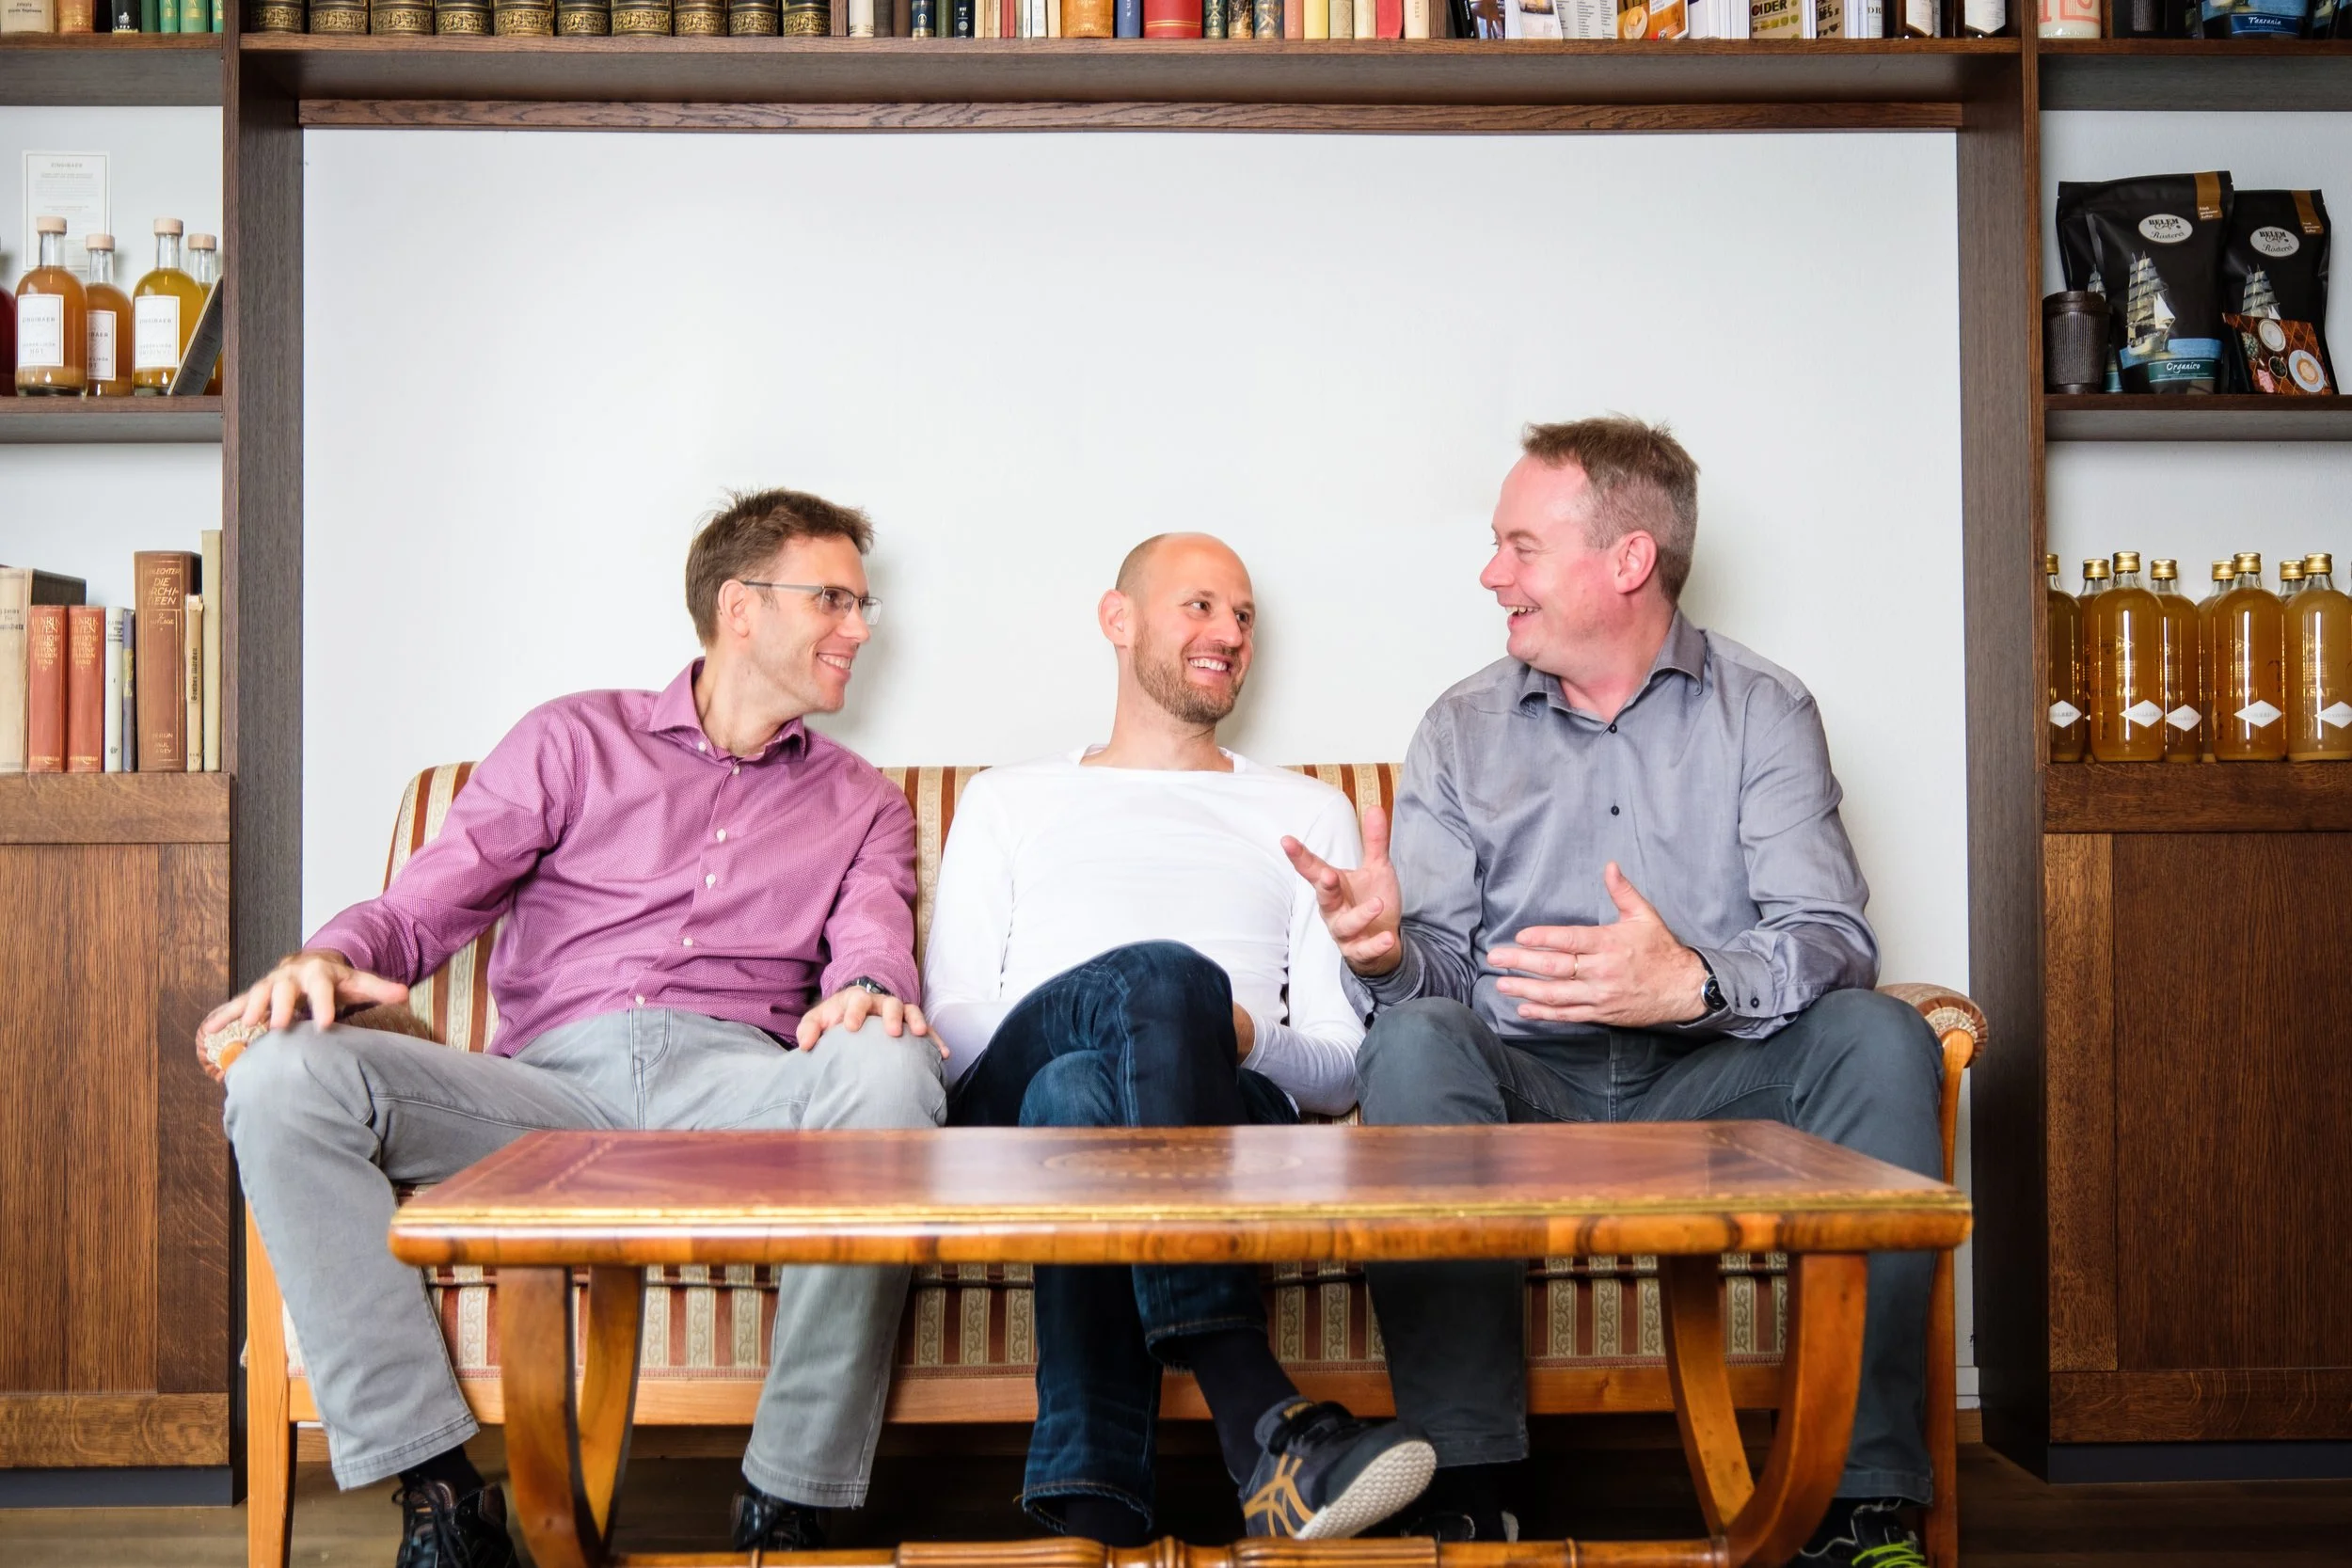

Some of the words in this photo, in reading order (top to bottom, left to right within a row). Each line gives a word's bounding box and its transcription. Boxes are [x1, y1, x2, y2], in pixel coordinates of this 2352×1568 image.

[1751, 0, 1788, 16] CIDER
[2248, 16, 2281, 25] Tanzania
[2148, 217, 2180, 226] BELEM
[2259, 230, 2287, 238] BELEM
[2166, 361, 2201, 374] Organico
[153, 577, 171, 587] DIE
